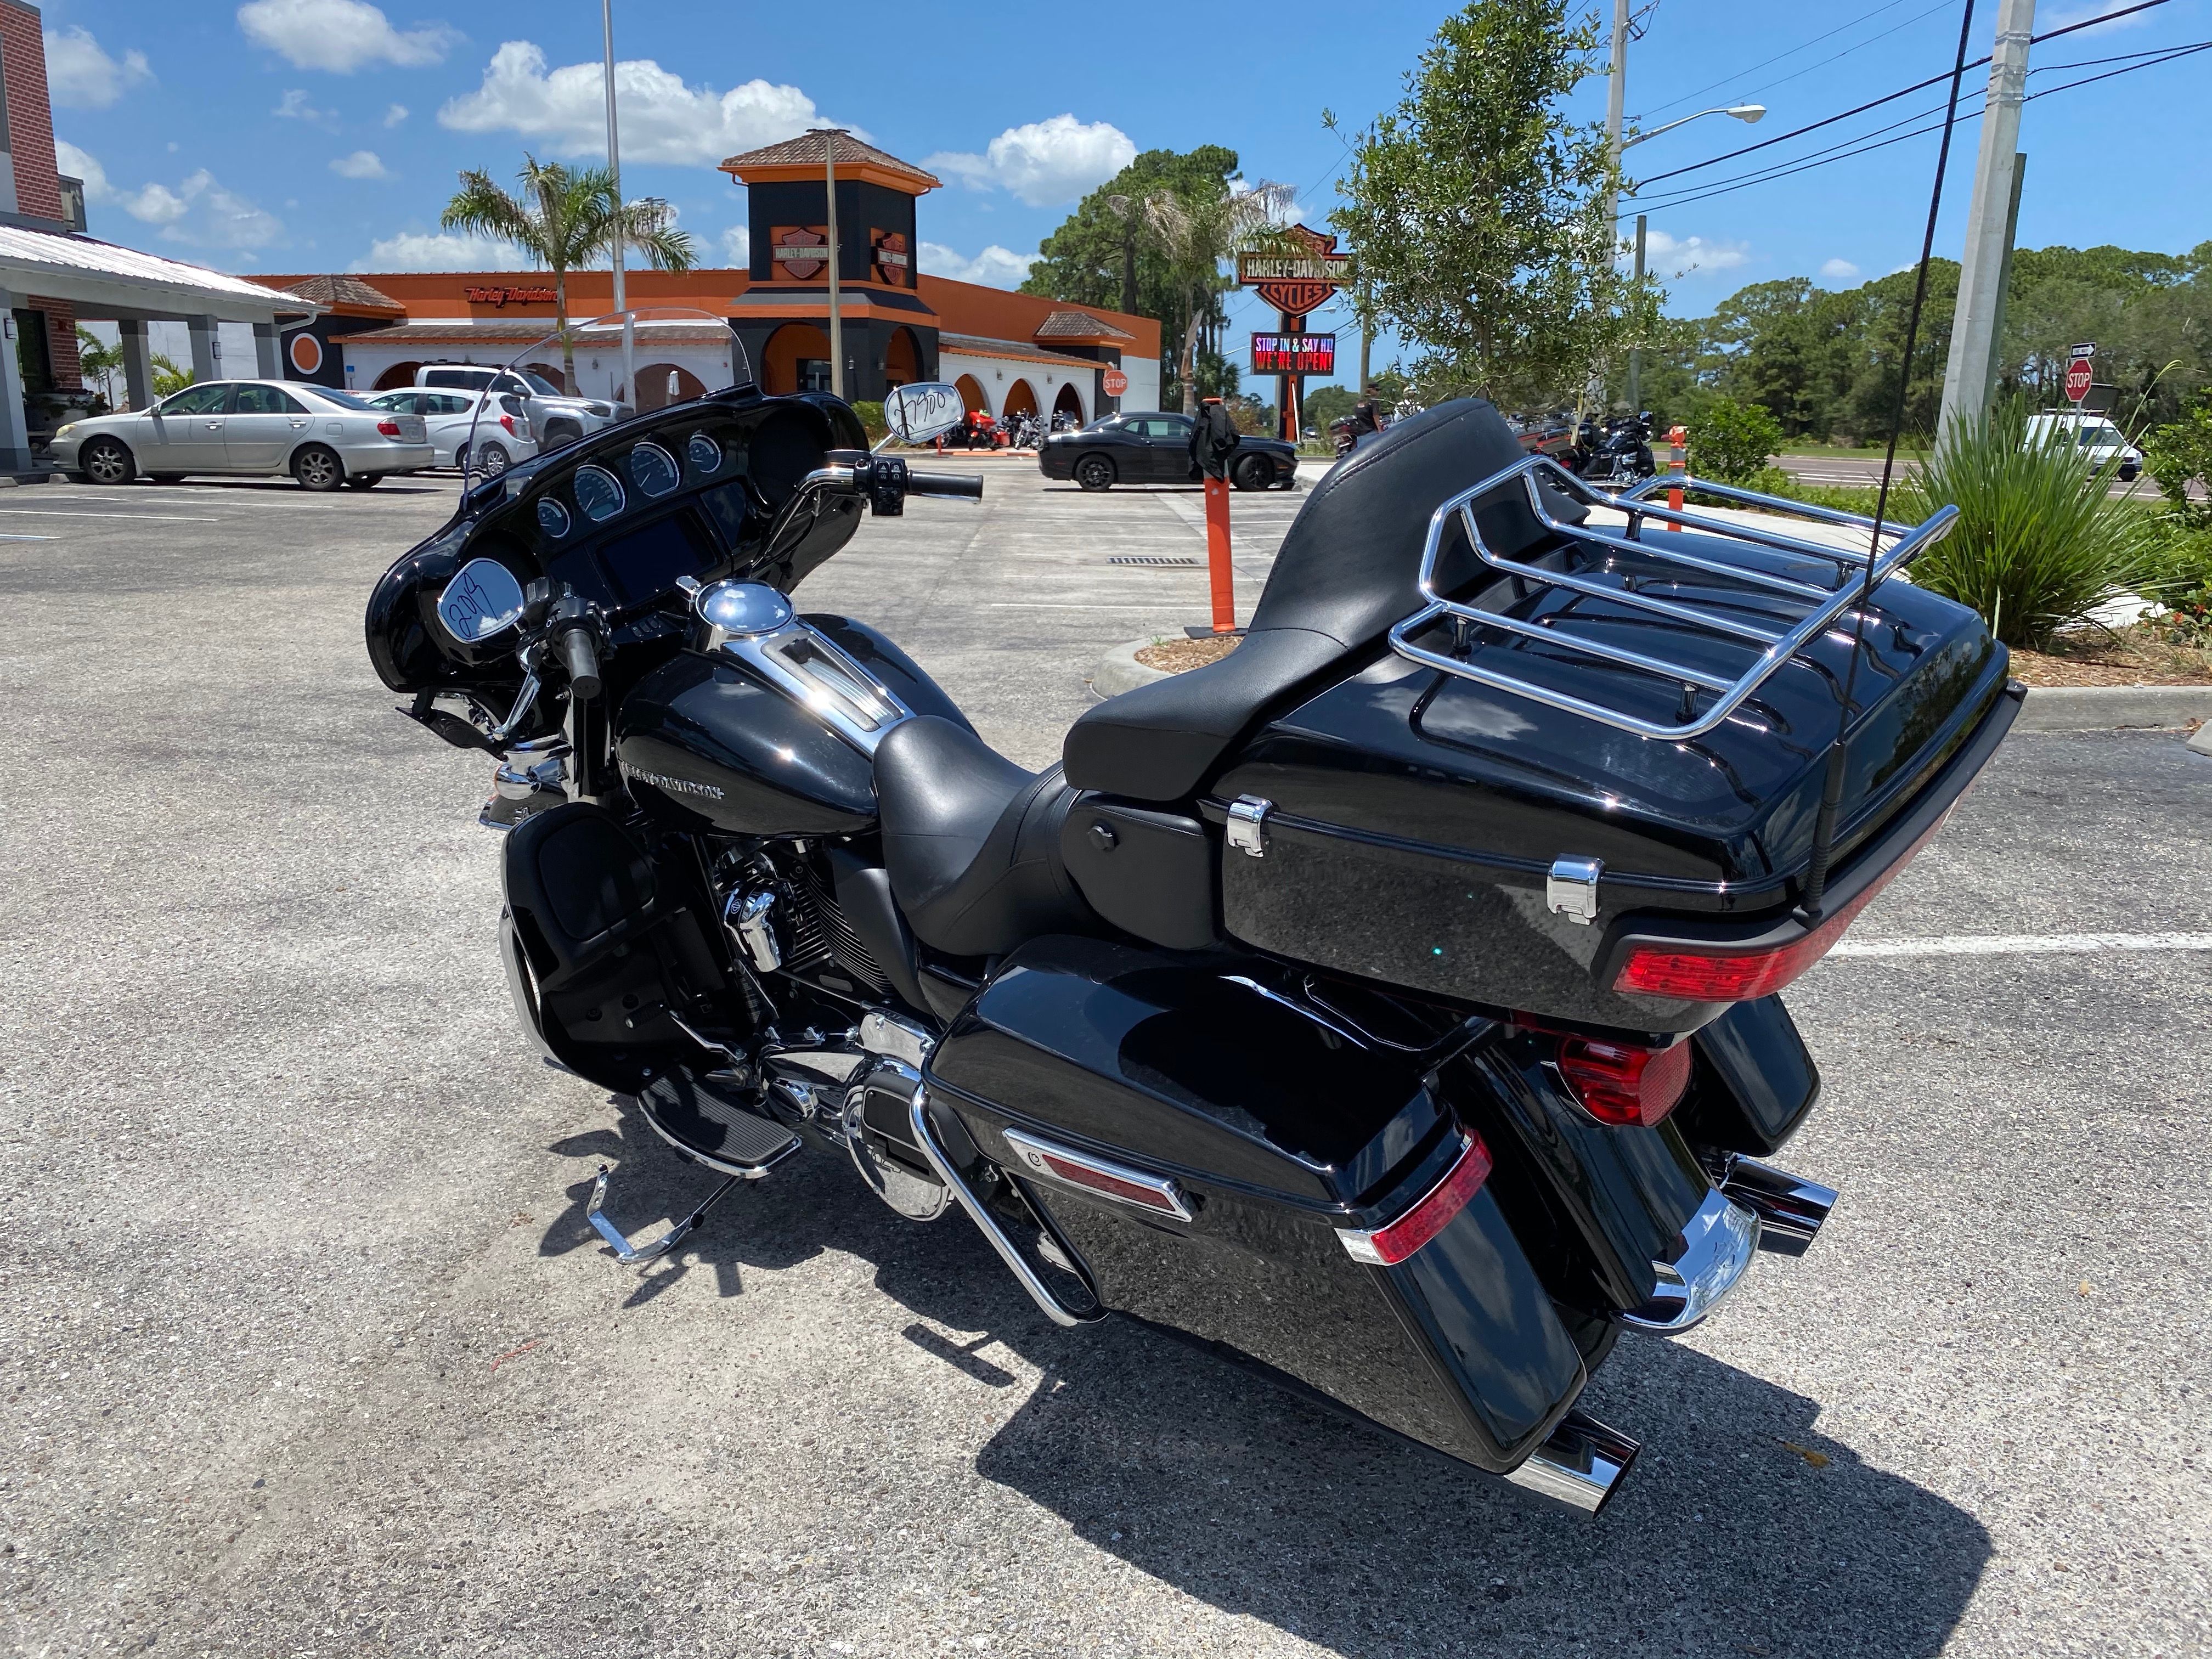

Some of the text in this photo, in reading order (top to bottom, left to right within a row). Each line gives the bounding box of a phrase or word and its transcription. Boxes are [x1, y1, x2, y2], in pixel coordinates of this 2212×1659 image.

[775, 247, 828, 258] HARLEY-DAVIDSON
[1270, 285, 1323, 308] CYCLES
[1256, 337, 1333, 352] STOP IN & SAY HI!
[1256, 352, 1332, 371] WE'RE OPEN!
[1105, 379, 1126, 388] STOP
[2068, 373, 2090, 388] STOP
